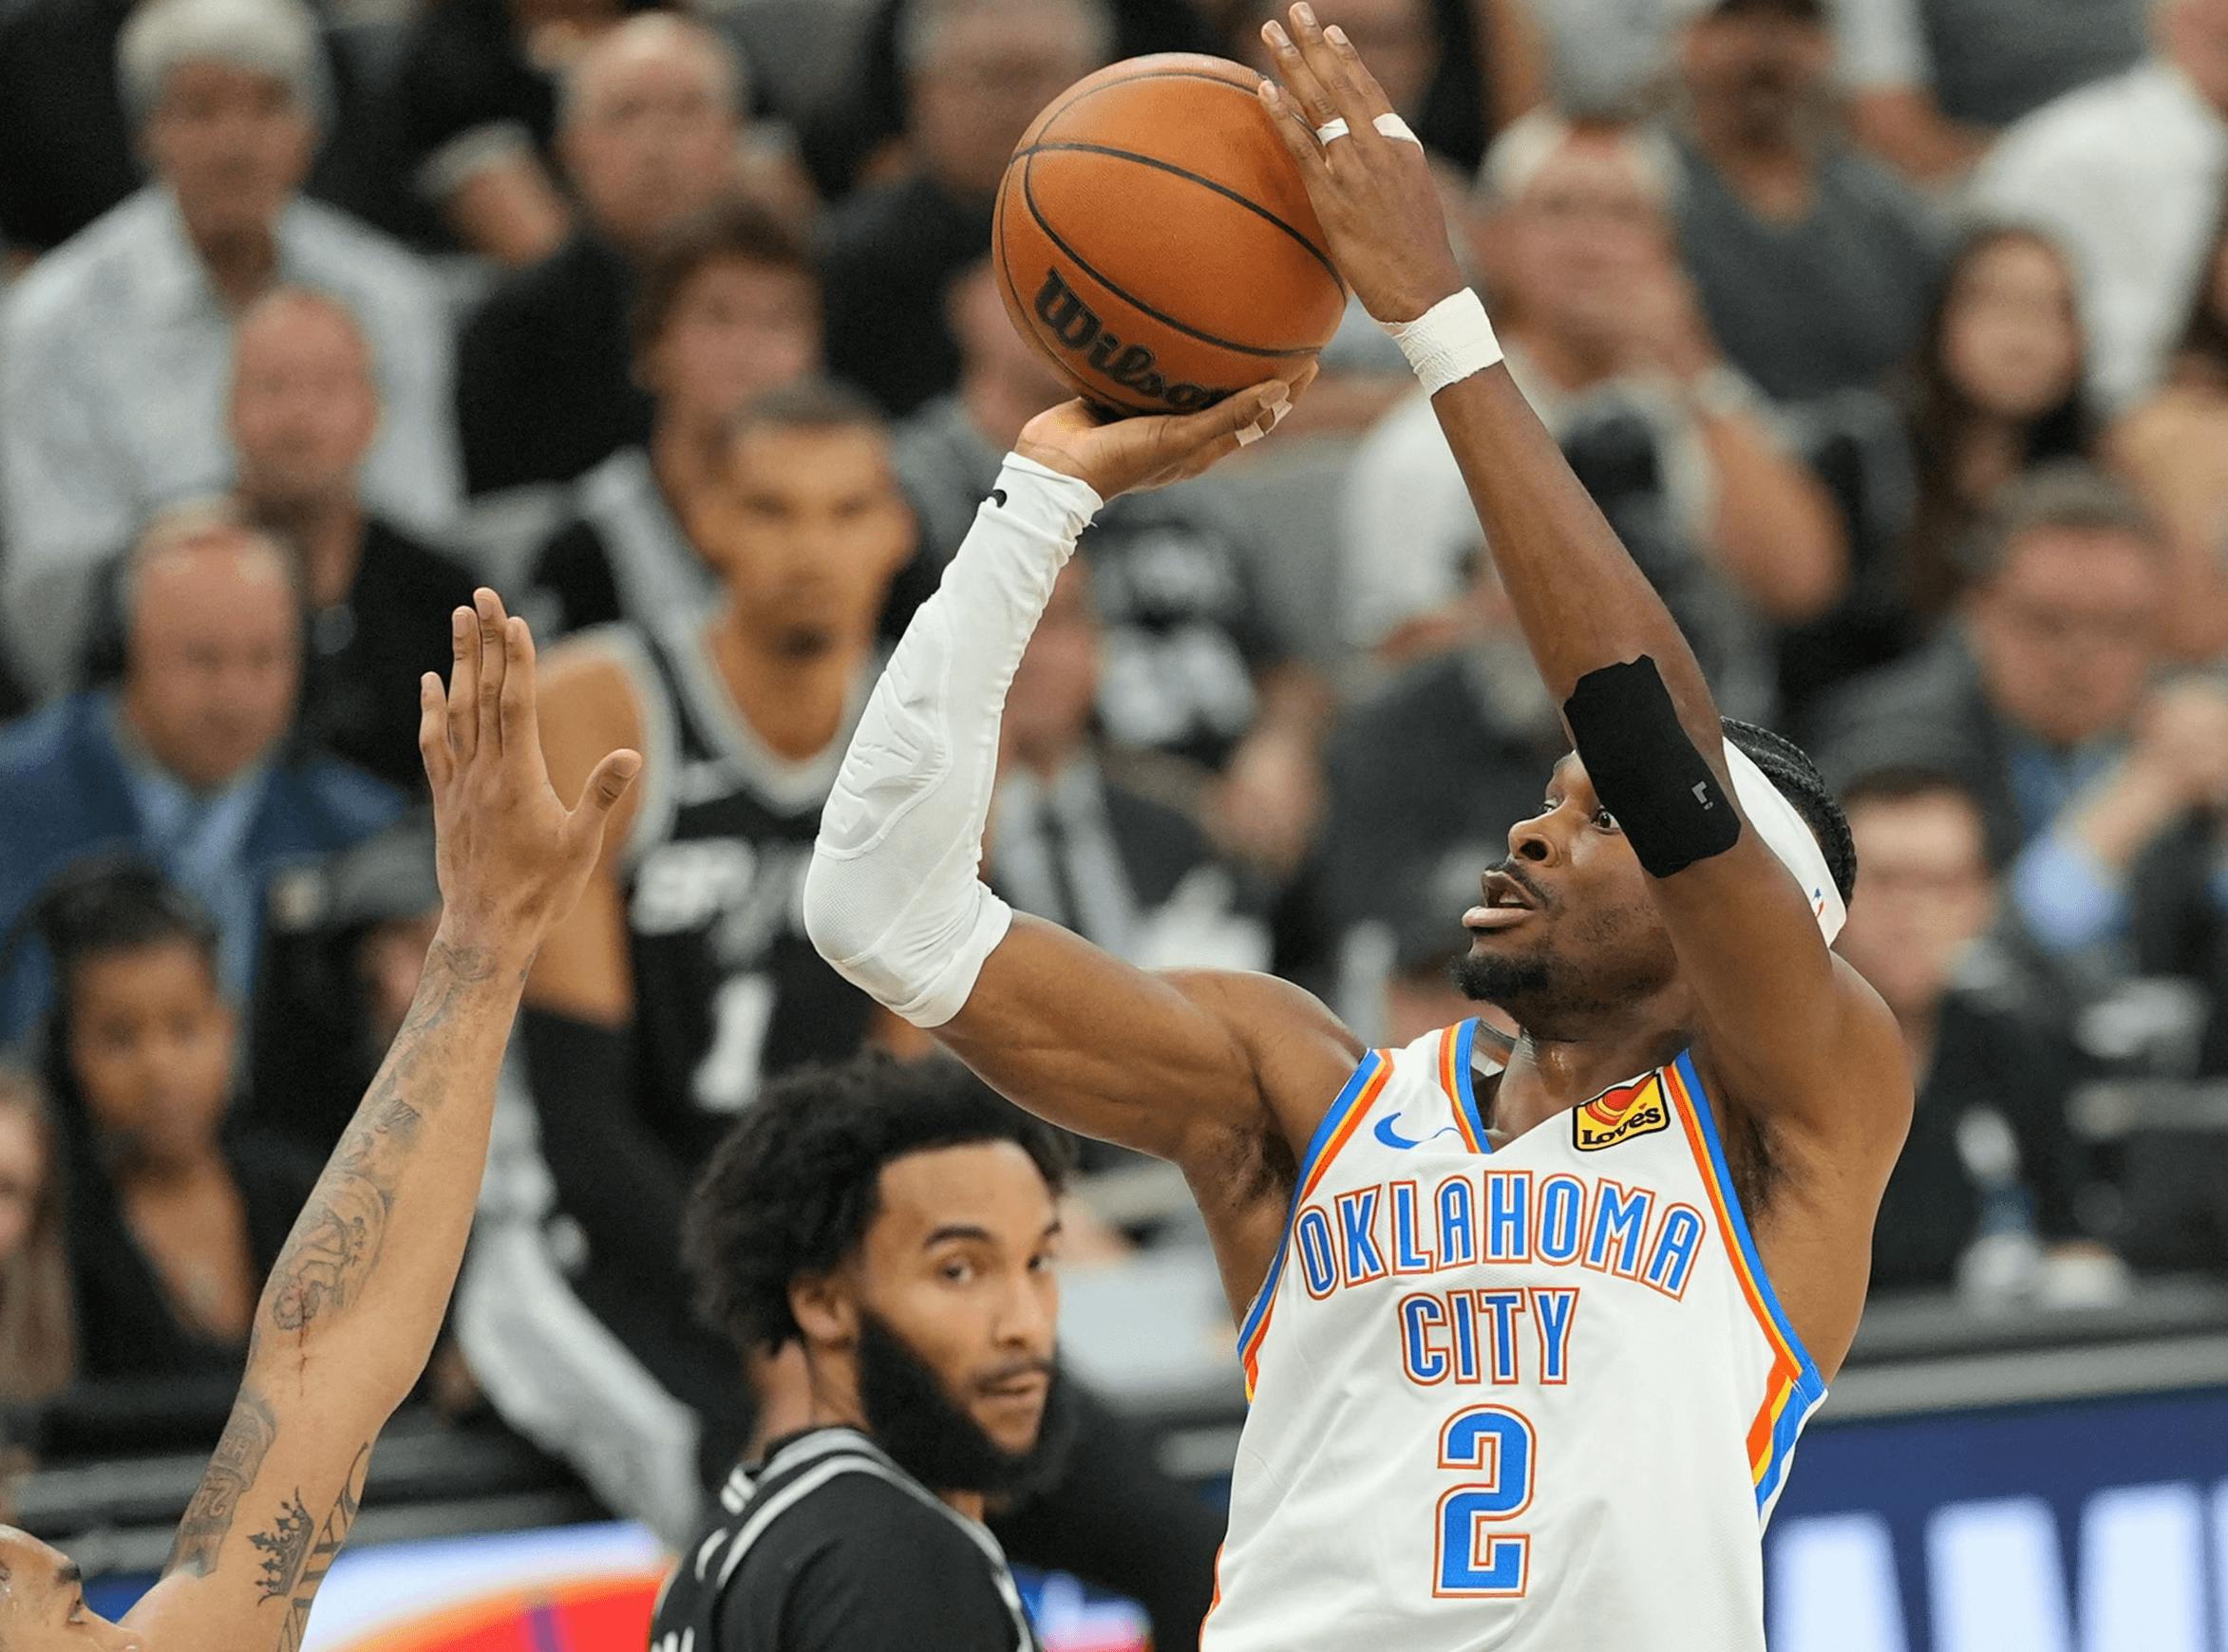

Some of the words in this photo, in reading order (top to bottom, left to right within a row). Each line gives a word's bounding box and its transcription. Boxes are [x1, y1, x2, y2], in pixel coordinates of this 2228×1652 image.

[692, 970, 775, 1111] 1
[1294, 1170, 1707, 1302] OKLAHOMA
[1397, 1286, 1580, 1386] CITY
[1432, 1403, 1537, 1599] 2
